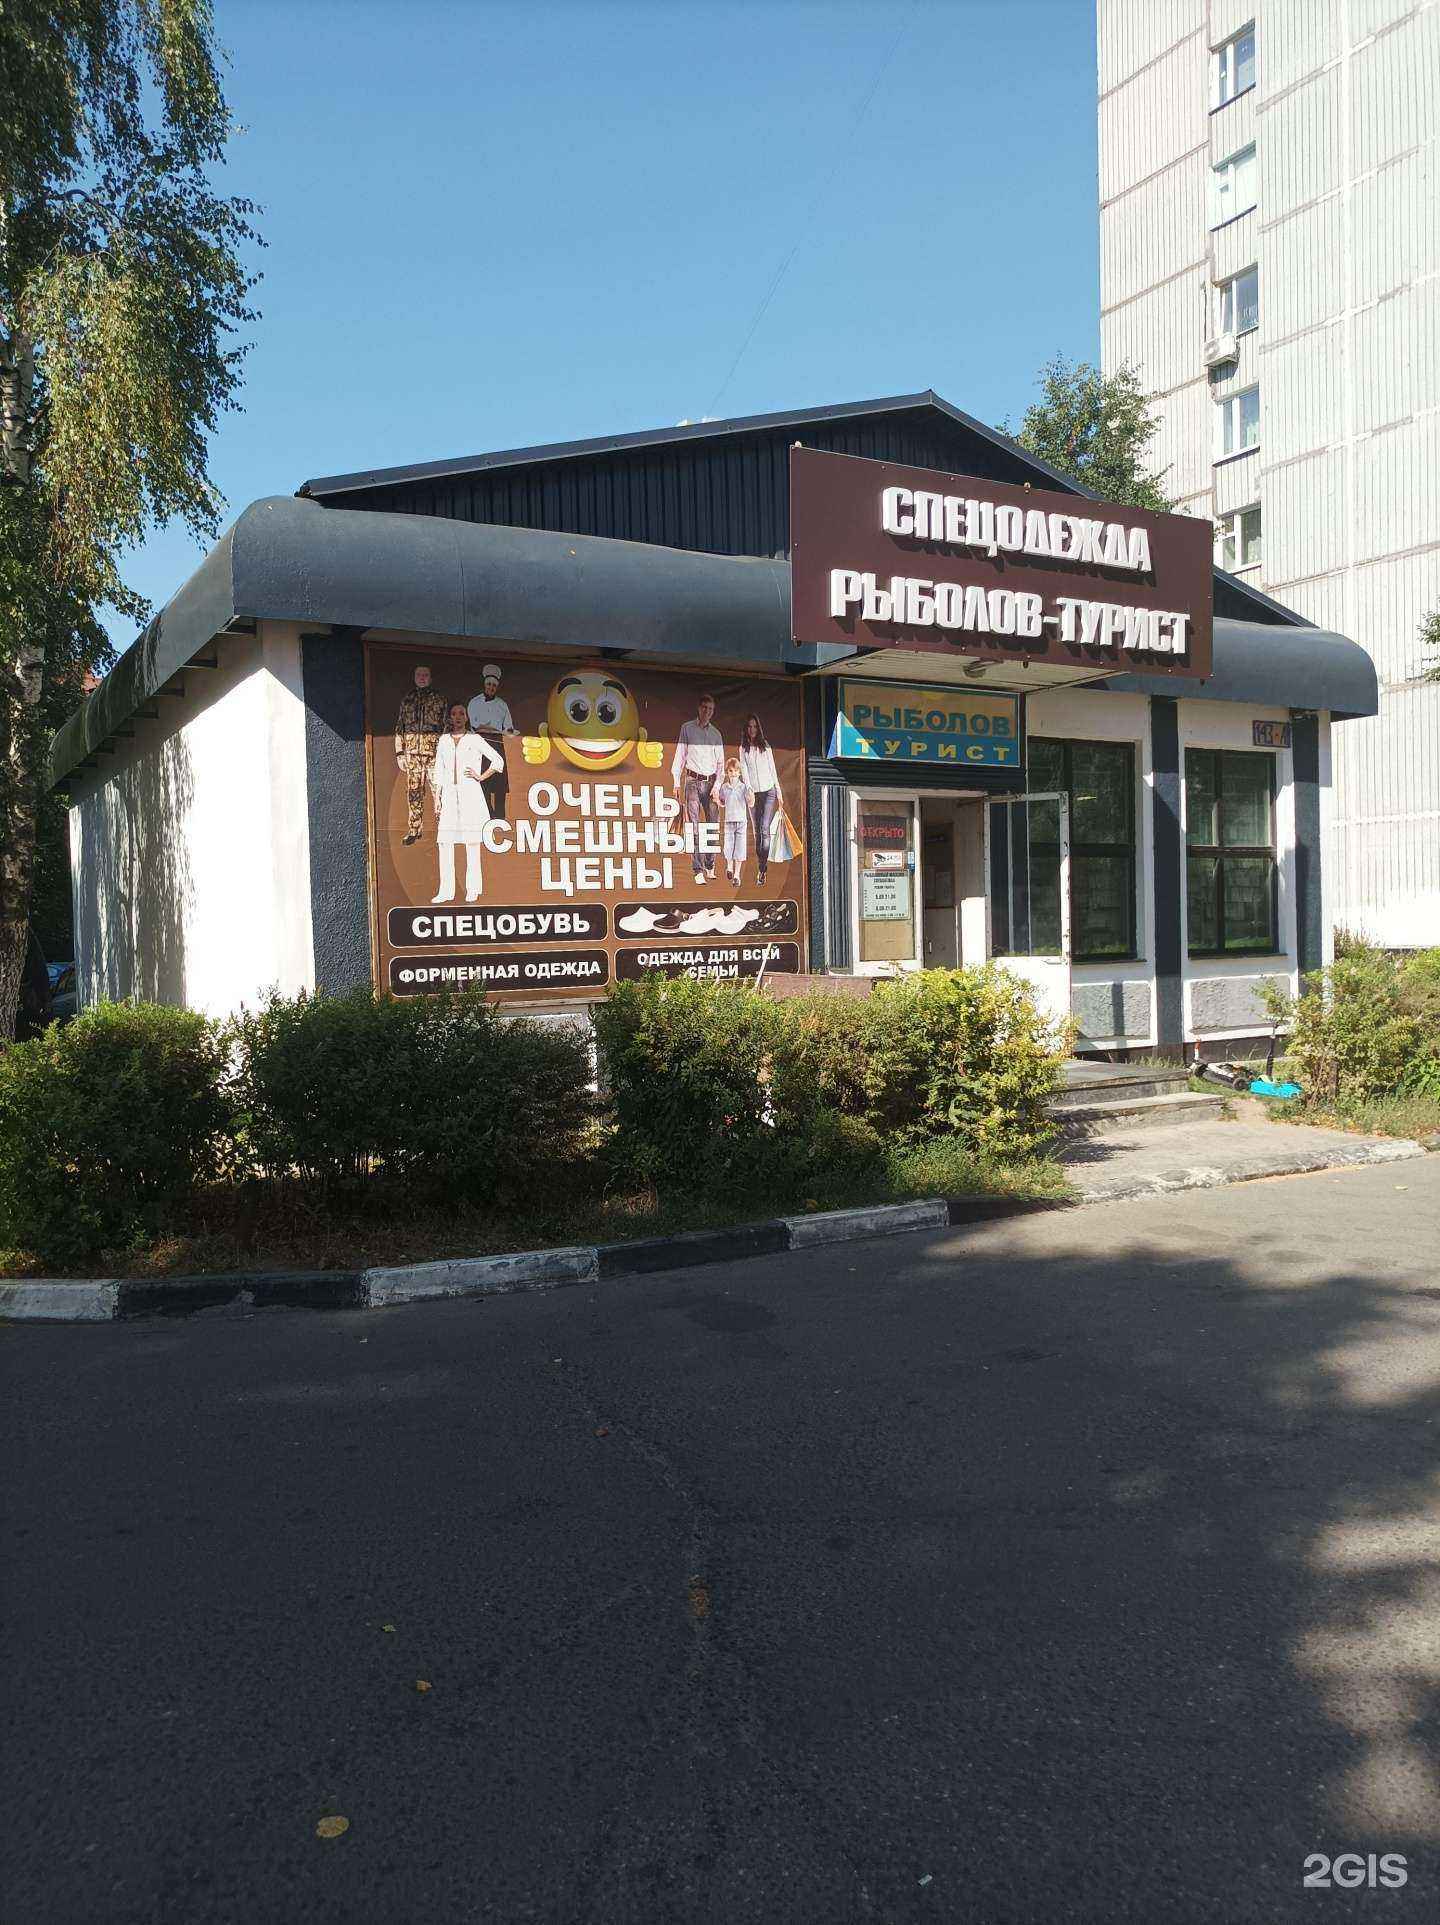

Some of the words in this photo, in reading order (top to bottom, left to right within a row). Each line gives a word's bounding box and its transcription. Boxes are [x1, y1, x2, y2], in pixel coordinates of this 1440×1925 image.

[882, 486, 1152, 572] СПЕЦОДЕЖДА
[829, 568, 1191, 654] РЫБОЛОВ-ТУРИСТ
[852, 704, 1011, 737] РЫБОЛОВ
[855, 738, 1010, 761] ТУРИСТ
[527, 781, 681, 818] ОЧЕНЬ
[482, 819, 721, 854] СМЕШНЫЕ
[540, 857, 674, 896] ЦЕНЫ
[411, 913, 590, 939] СПЕЦОБУВЬ
[399, 964, 519, 983] ФОРМЕННАЯ
[524, 961, 601, 979] ОДЕЖДА
[637, 951, 704, 967] ОДЕЖДА
[708, 949, 738, 964] ДЛЯ
[743, 946, 780, 961] ВСЕЙ
[687, 964, 739, 979] СЕМЬИ
